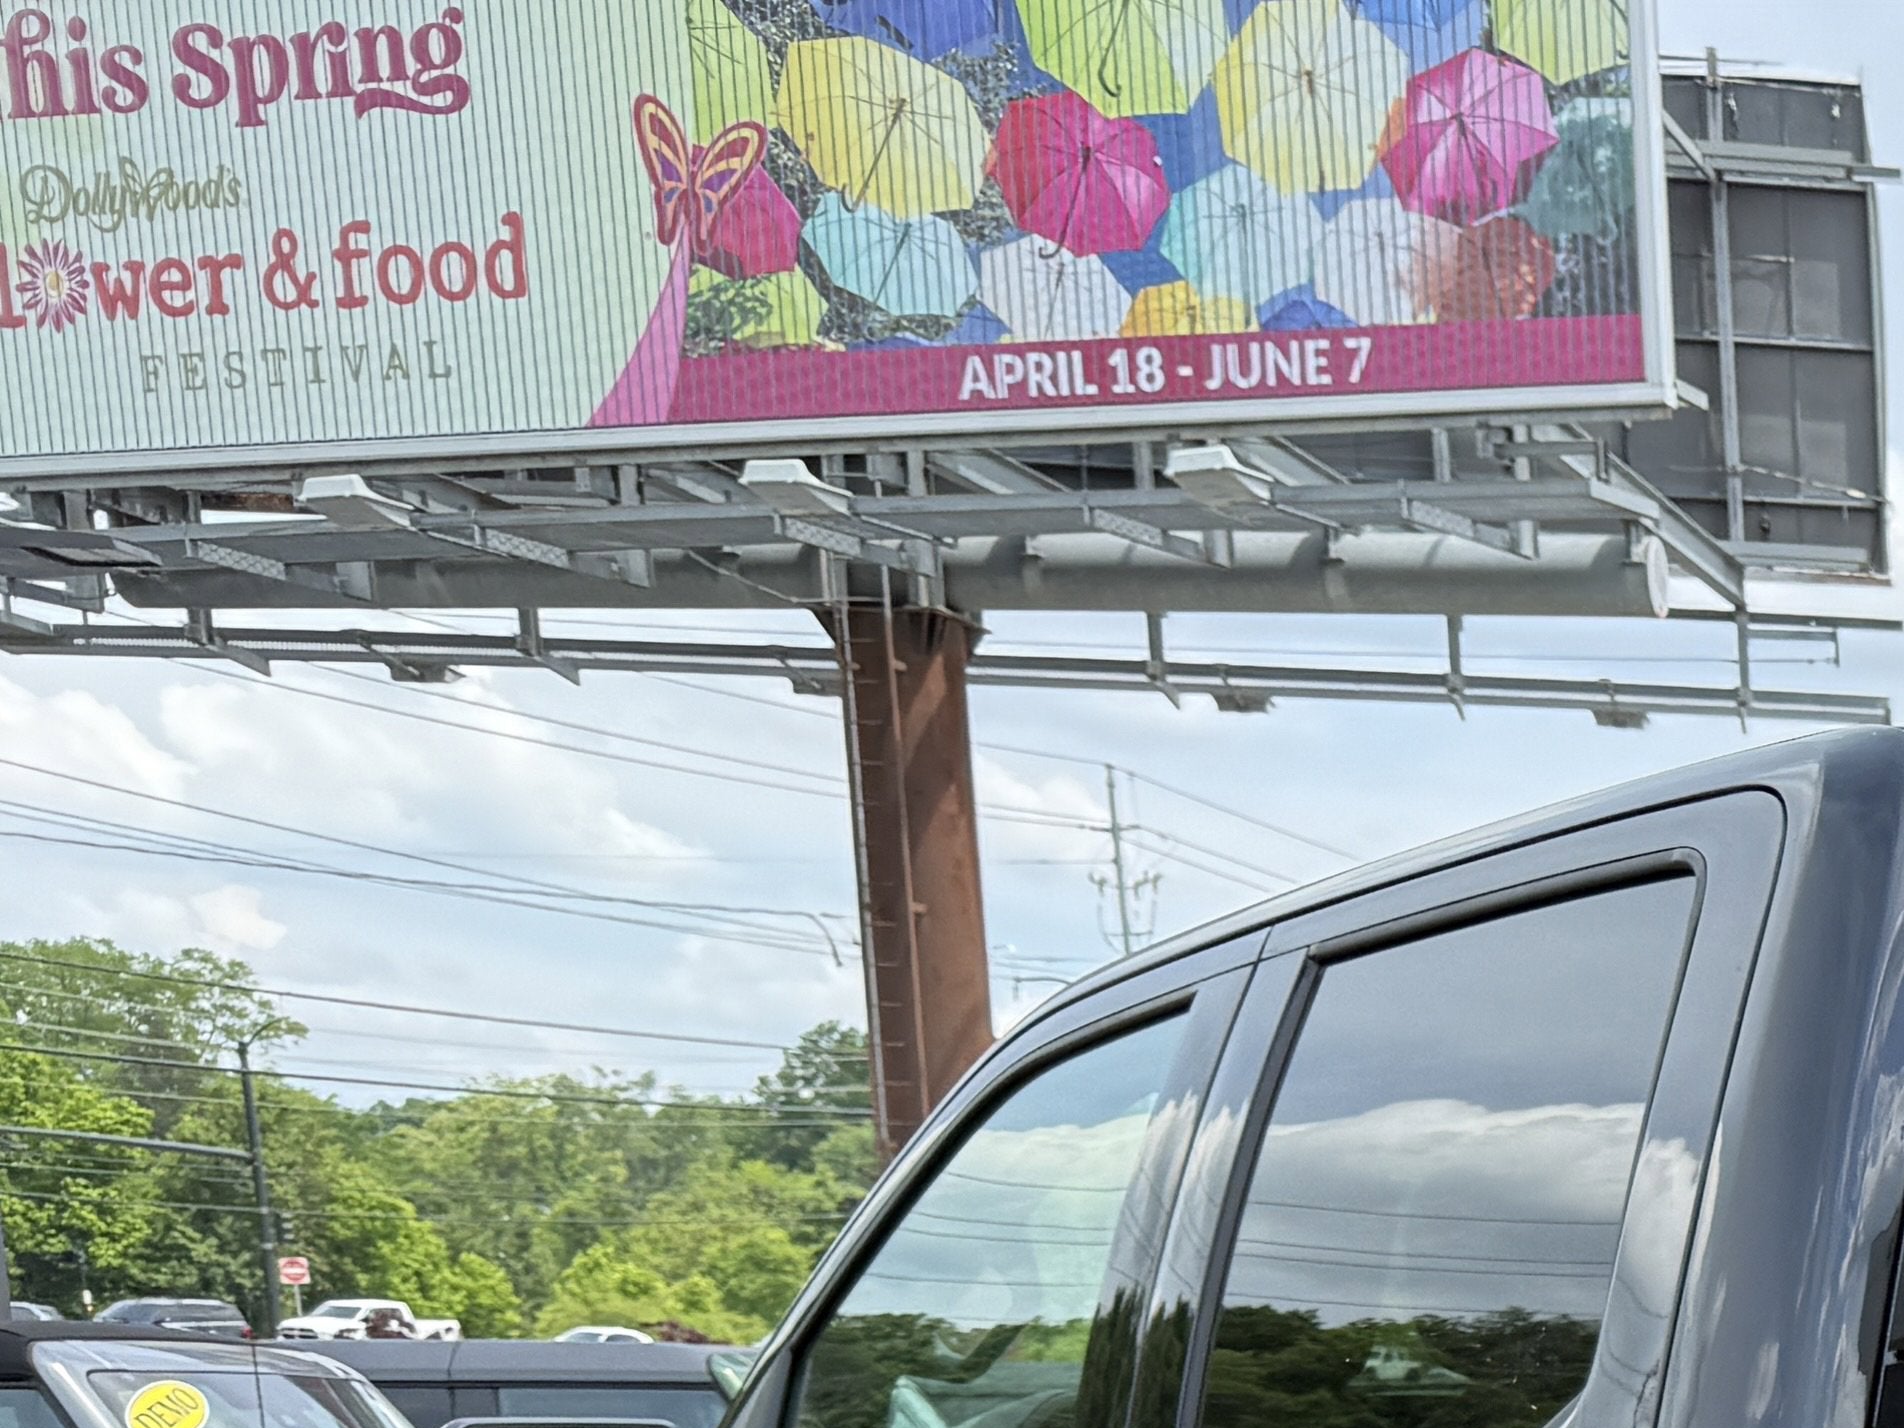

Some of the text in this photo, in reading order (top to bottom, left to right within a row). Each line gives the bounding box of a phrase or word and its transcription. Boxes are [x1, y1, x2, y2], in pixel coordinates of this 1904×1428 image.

[0, 6, 470, 128] his Spring
[263, 227, 320, 311] &
[331, 210, 527, 310] food
[140, 340, 452, 394] FESTIVAL
[958, 349, 1099, 401] APRIL
[1107, 346, 1166, 395] 18
[1203, 338, 1333, 390] JUNE
[1342, 336, 1373, 384] 7
